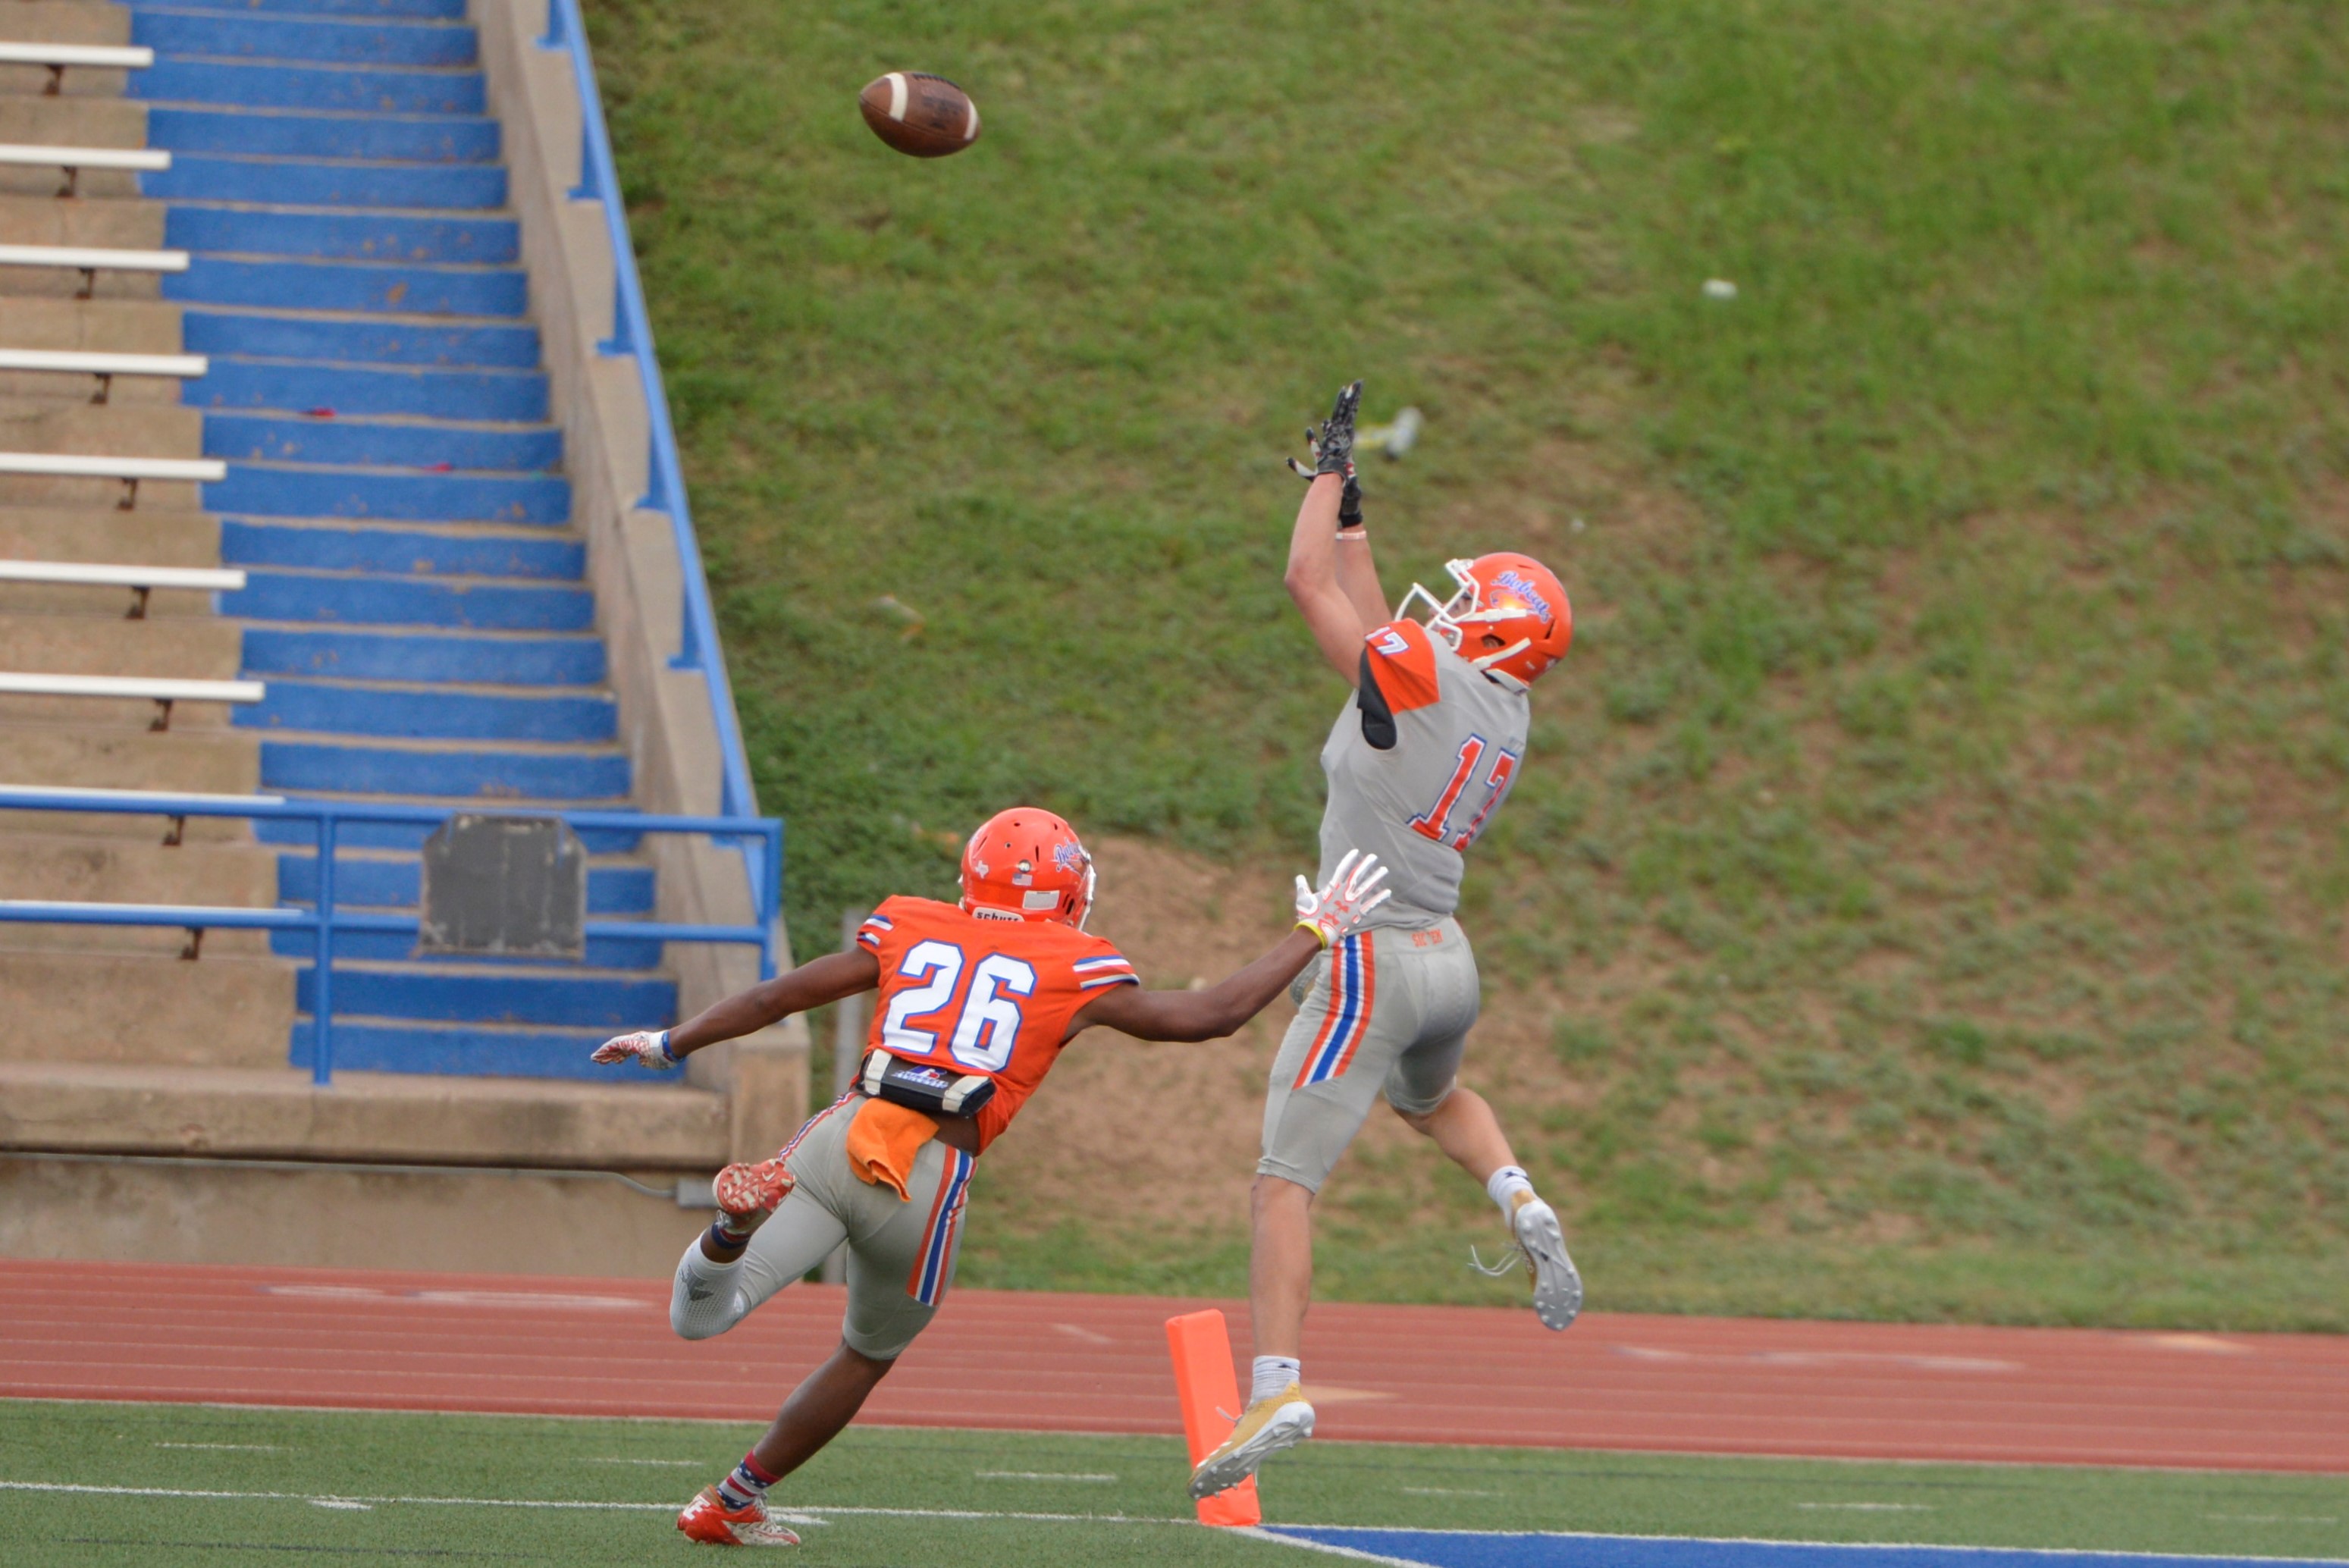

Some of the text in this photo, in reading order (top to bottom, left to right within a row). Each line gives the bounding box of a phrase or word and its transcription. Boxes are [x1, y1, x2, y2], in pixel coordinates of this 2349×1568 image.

[1491, 570, 1552, 623] Bobcats
[1365, 626, 1410, 656] 17
[1406, 733, 1517, 852] 17
[882, 938, 1037, 1072] 26
